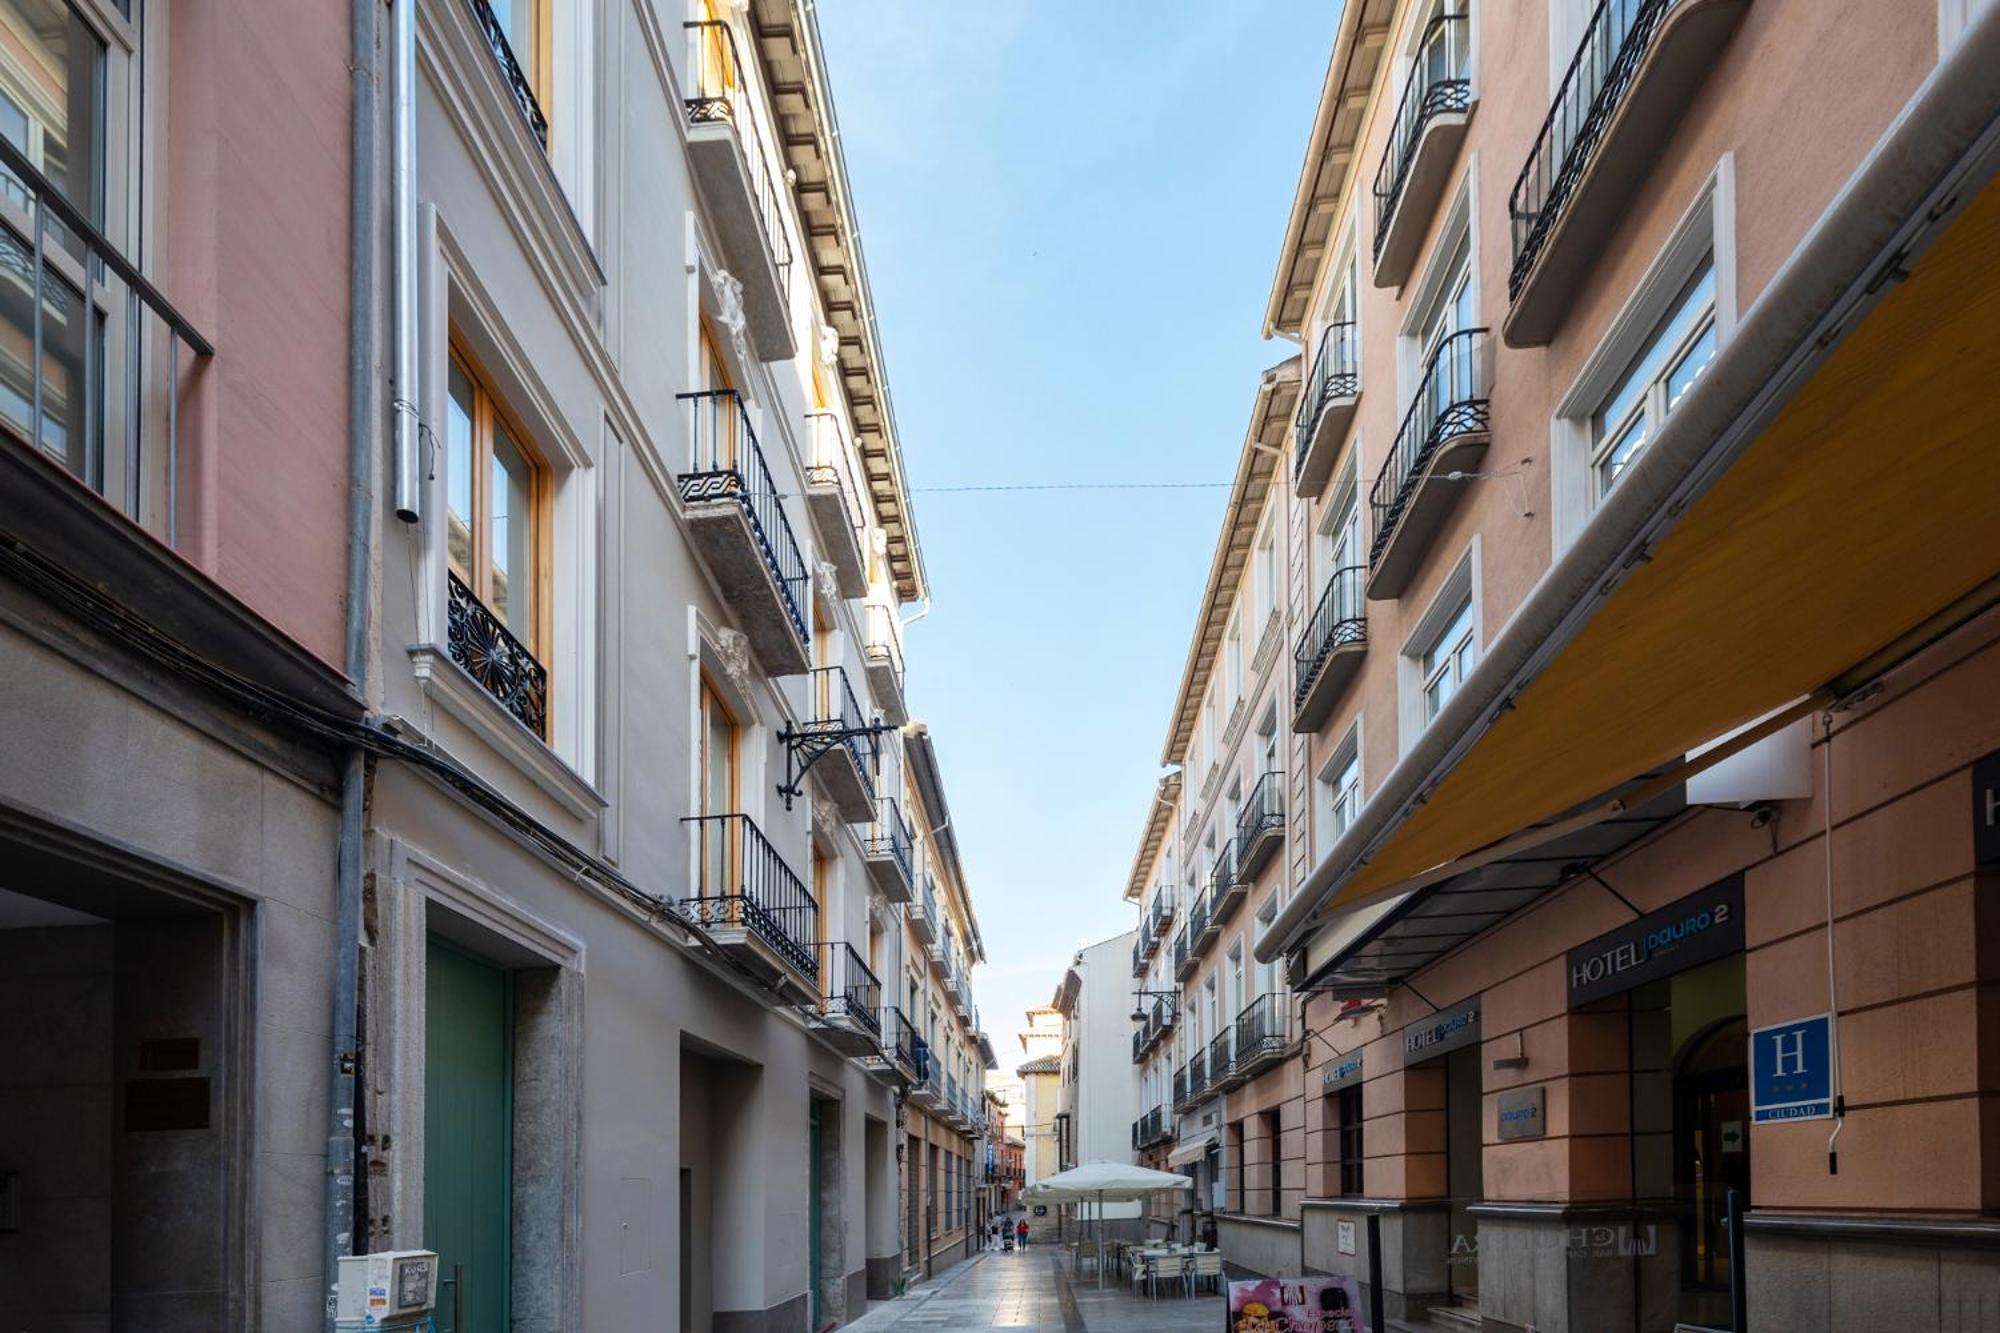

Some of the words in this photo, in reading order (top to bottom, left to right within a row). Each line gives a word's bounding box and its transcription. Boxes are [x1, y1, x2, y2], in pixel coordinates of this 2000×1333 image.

[1572, 942, 1645, 989] HOTEL
[1714, 903, 1729, 924] 2
[1407, 1027, 1441, 1053] HOTEL
[1771, 1029, 1808, 1077] H
[1768, 1105, 1816, 1119] CIUDAD
